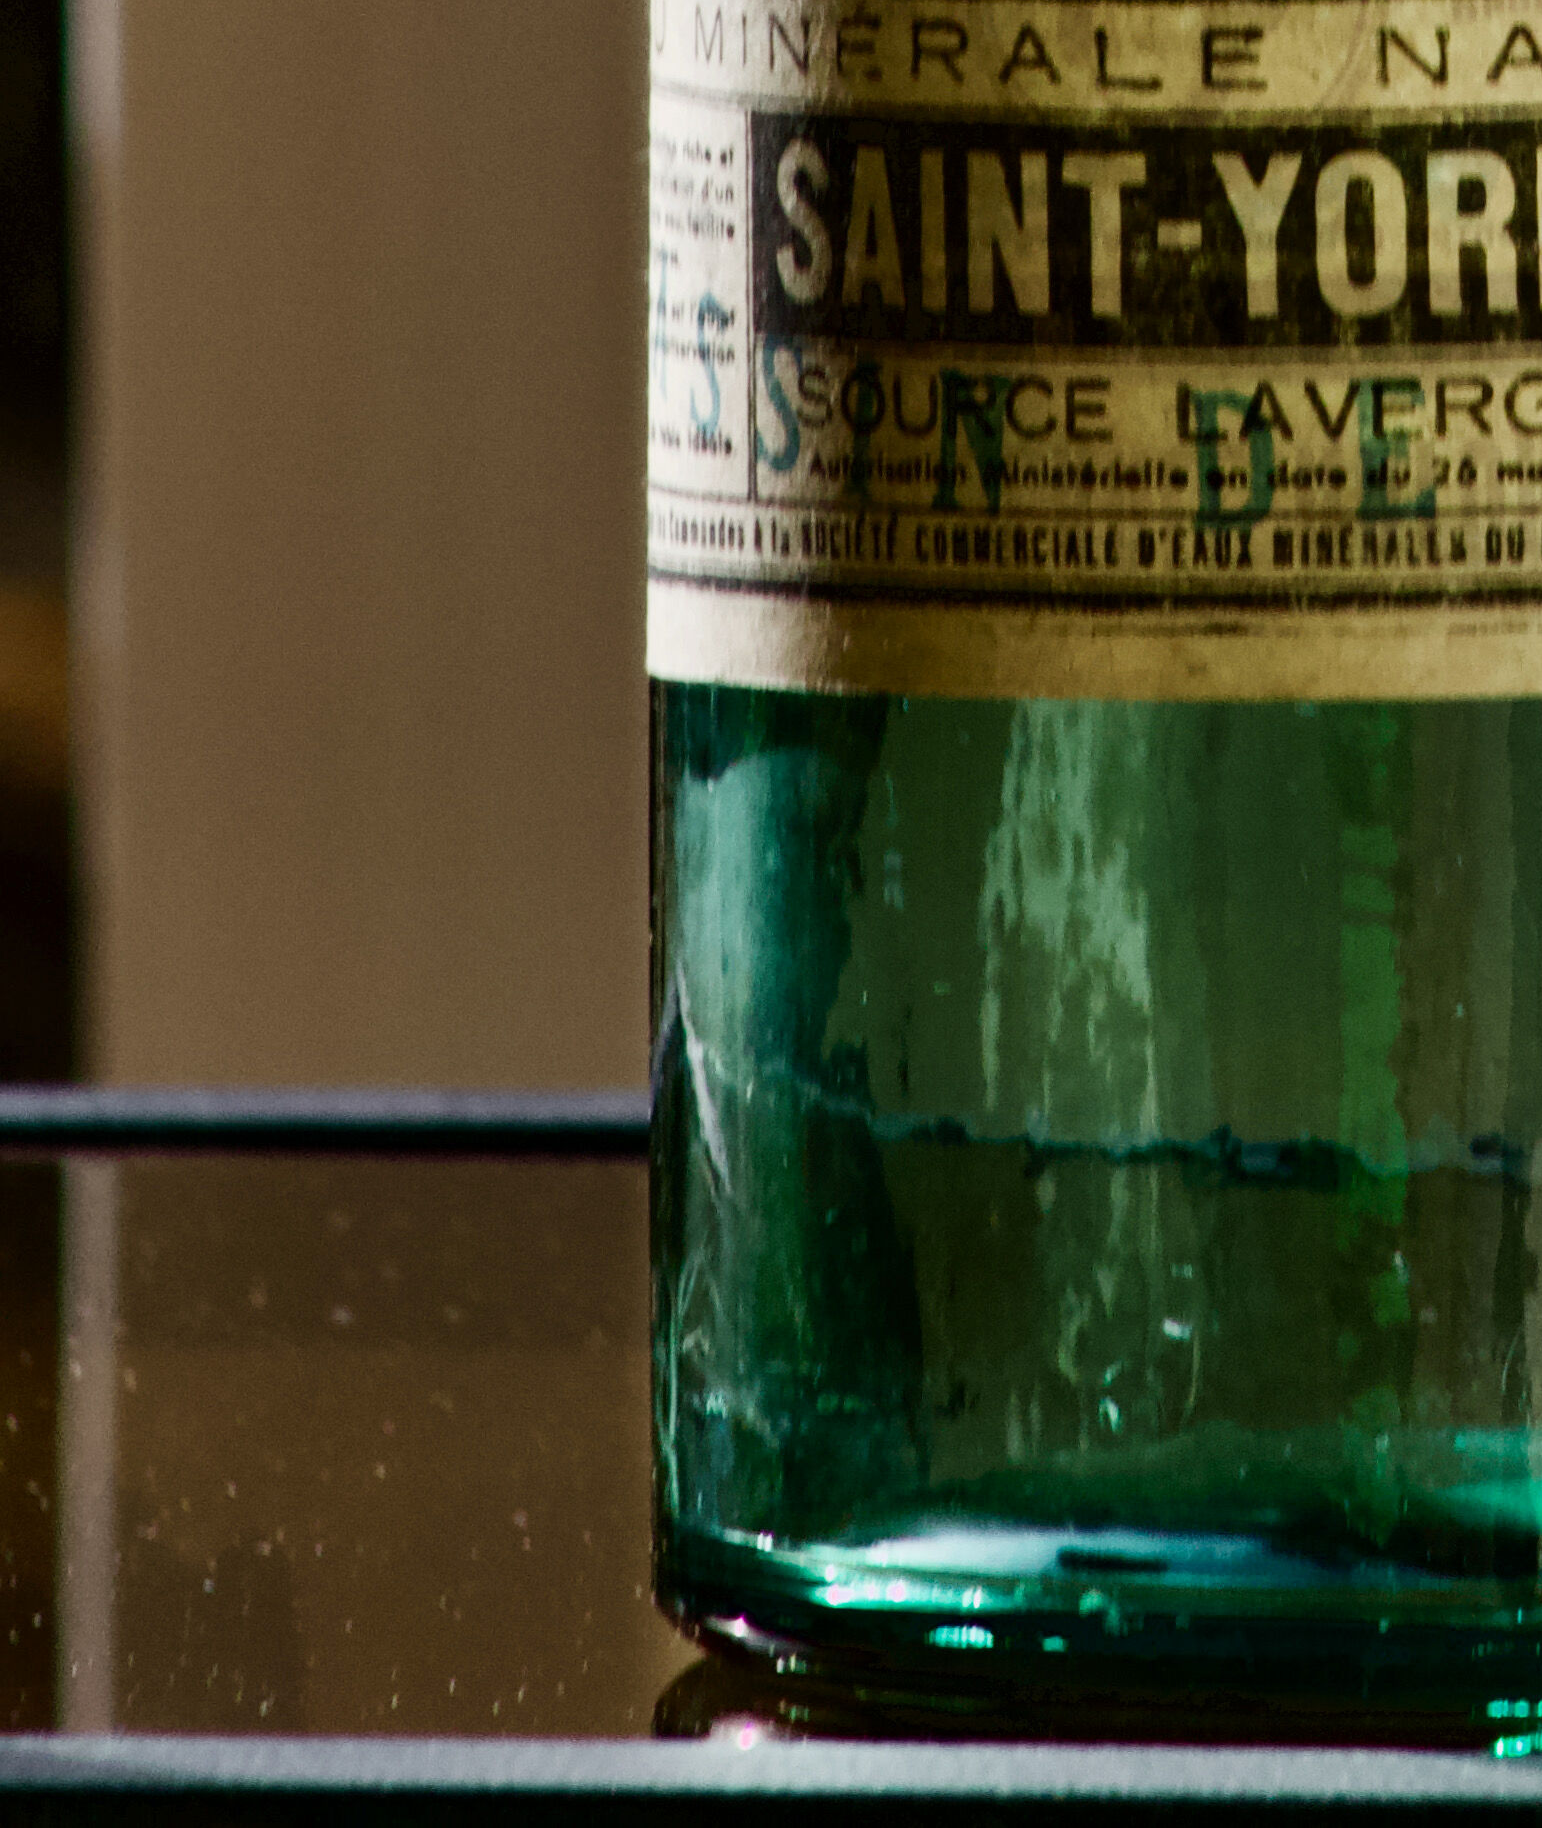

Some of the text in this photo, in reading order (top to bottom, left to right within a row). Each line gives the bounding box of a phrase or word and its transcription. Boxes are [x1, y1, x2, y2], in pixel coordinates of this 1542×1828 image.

[694, 1, 1269, 91] MINÉRALE
[798, 365, 1113, 441] SOURCE
[913, 519, 1117, 567] COMMERCIALE
[1485, 520, 1524, 564] DU
